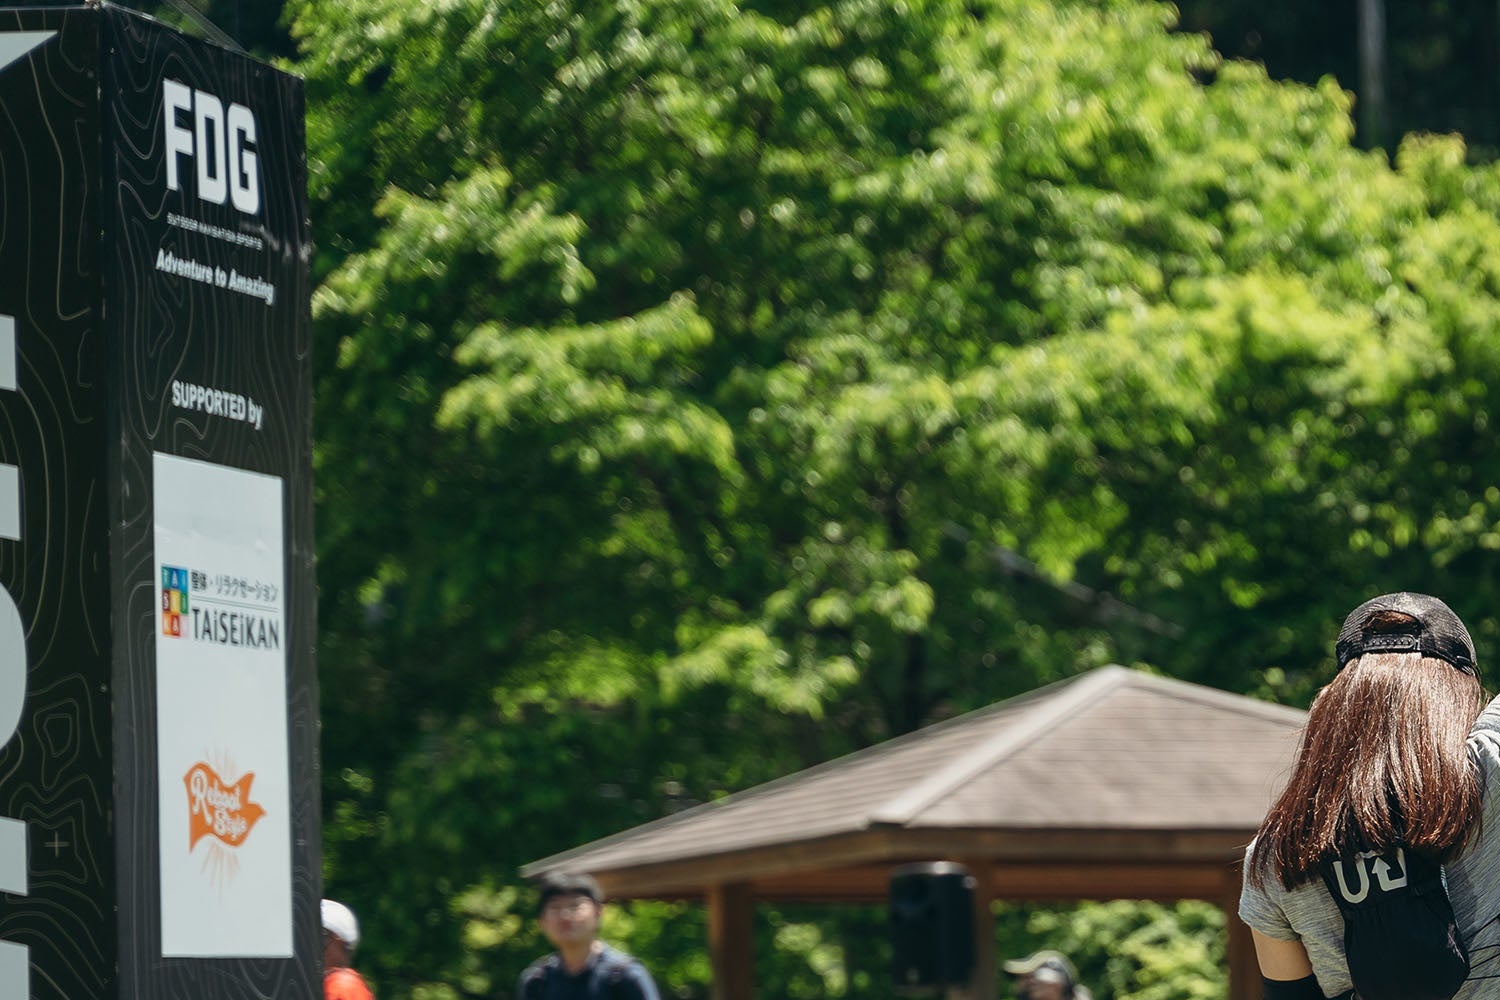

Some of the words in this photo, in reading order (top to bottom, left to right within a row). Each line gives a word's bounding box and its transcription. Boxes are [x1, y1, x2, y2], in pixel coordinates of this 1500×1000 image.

[163, 78, 260, 216] FDG
[155, 247, 214, 285] Adventure
[214, 265, 227, 288] to
[228, 268, 275, 306] Amazing
[171, 379, 246, 421] SUPPORTED
[247, 397, 262, 430] by
